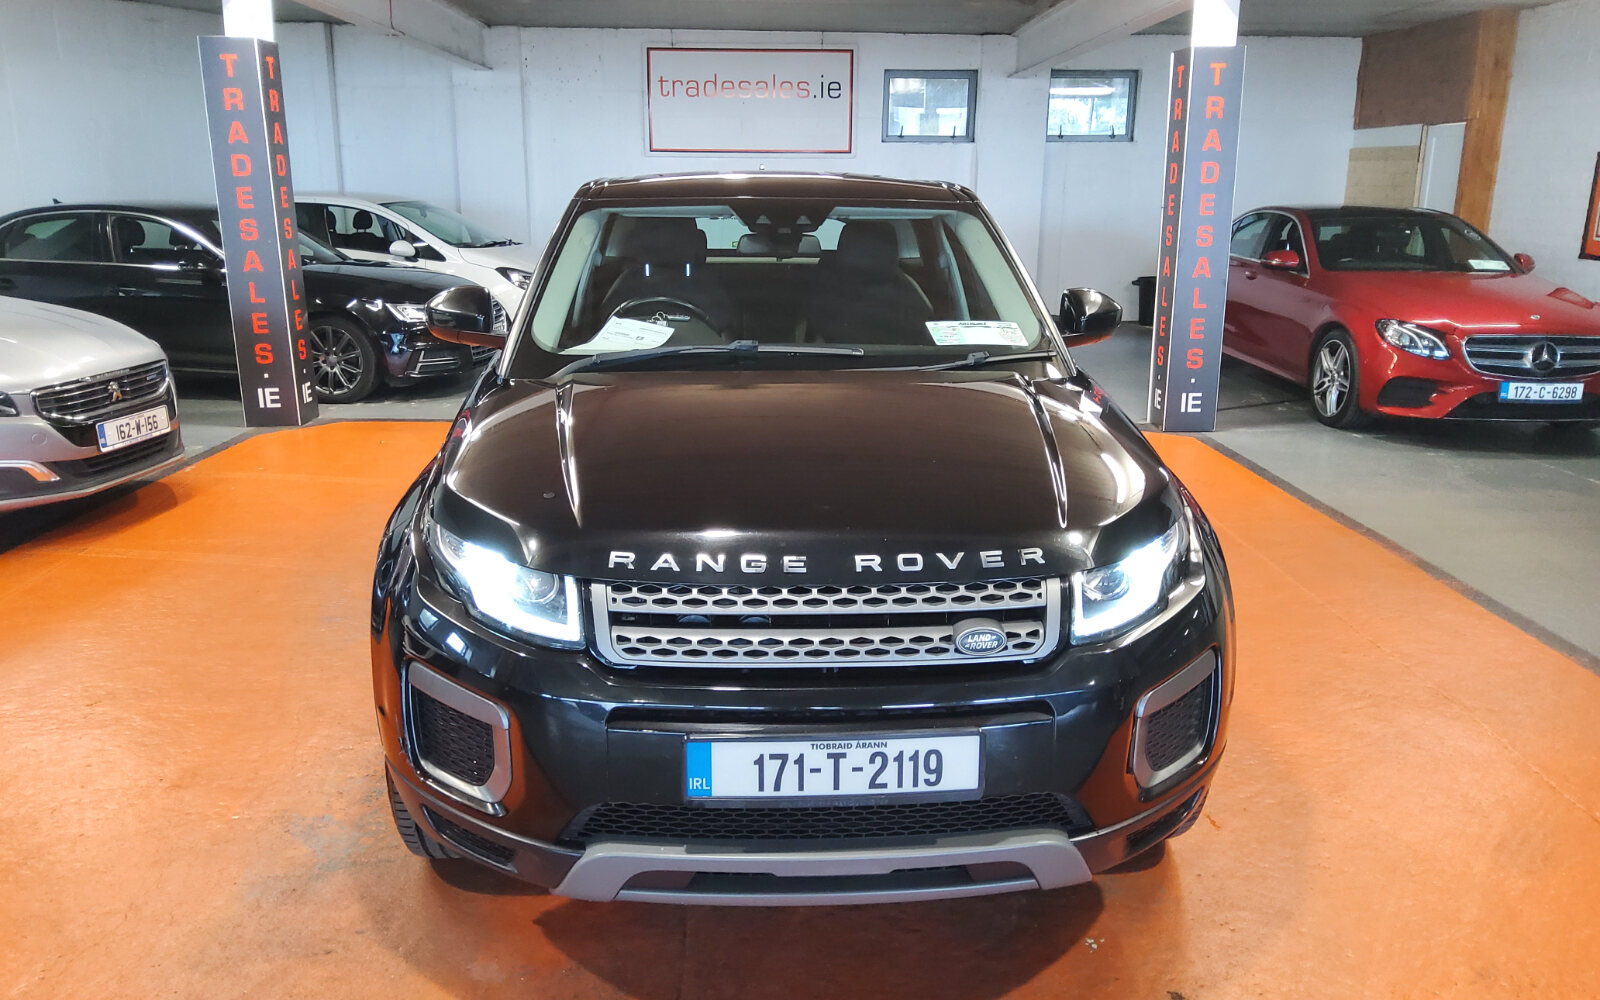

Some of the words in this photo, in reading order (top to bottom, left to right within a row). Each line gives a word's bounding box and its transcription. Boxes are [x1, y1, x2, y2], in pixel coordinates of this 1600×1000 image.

[657, 73, 843, 99] tradesales.ie
[1513, 386, 1578, 399] 172-C-6298
[115, 414, 159, 441] 162-W-156
[608, 551, 807, 574] RANGE
[855, 547, 1046, 572] ROVER
[967, 633, 991, 642] LAND
[970, 641, 998, 649] ROVER
[810, 742, 853, 750] TIOBRAID
[753, 749, 943, 792] 171-T-2119
[689, 777, 710, 790] IRL
